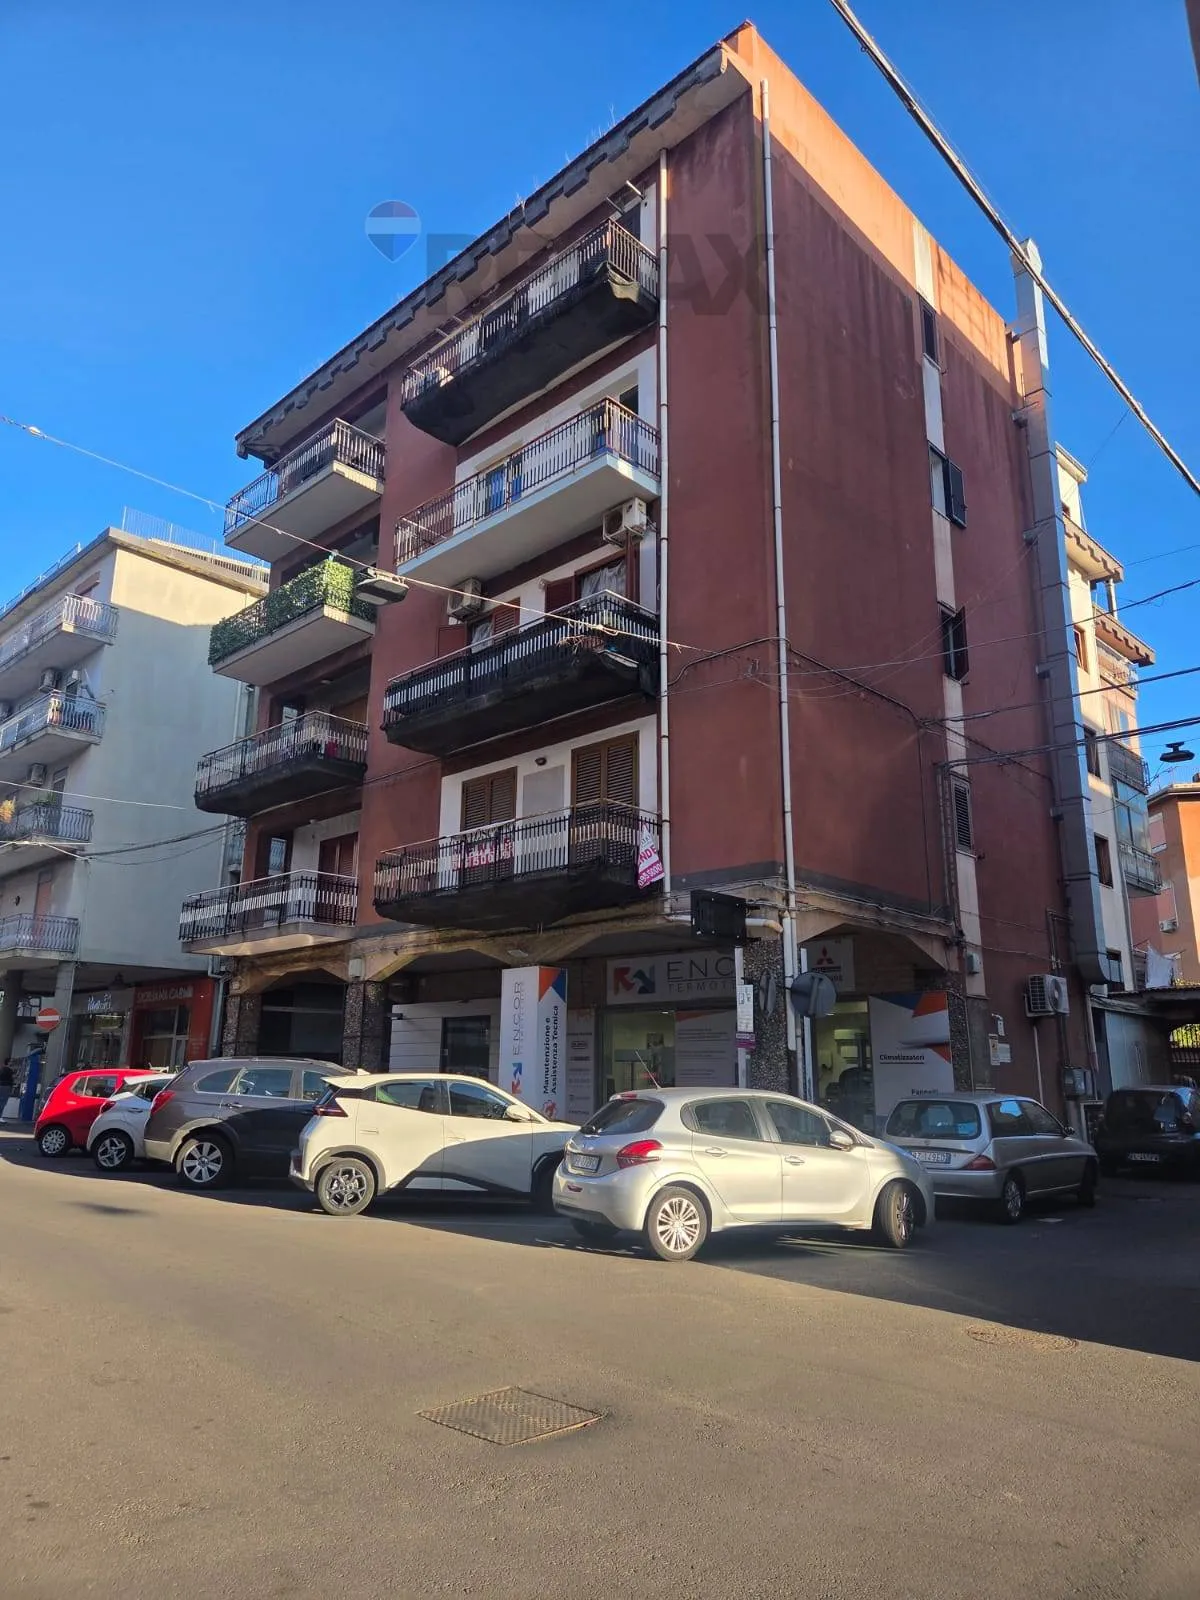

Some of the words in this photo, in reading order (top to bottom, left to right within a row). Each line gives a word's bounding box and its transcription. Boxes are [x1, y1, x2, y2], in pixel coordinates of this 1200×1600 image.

[513, 982, 522, 1056] ENCOR
[543, 1026, 551, 1095] Manutenzione
[550, 1043, 558, 1095] Assistenza
[880, 1053, 925, 1061] Climatizzatori
